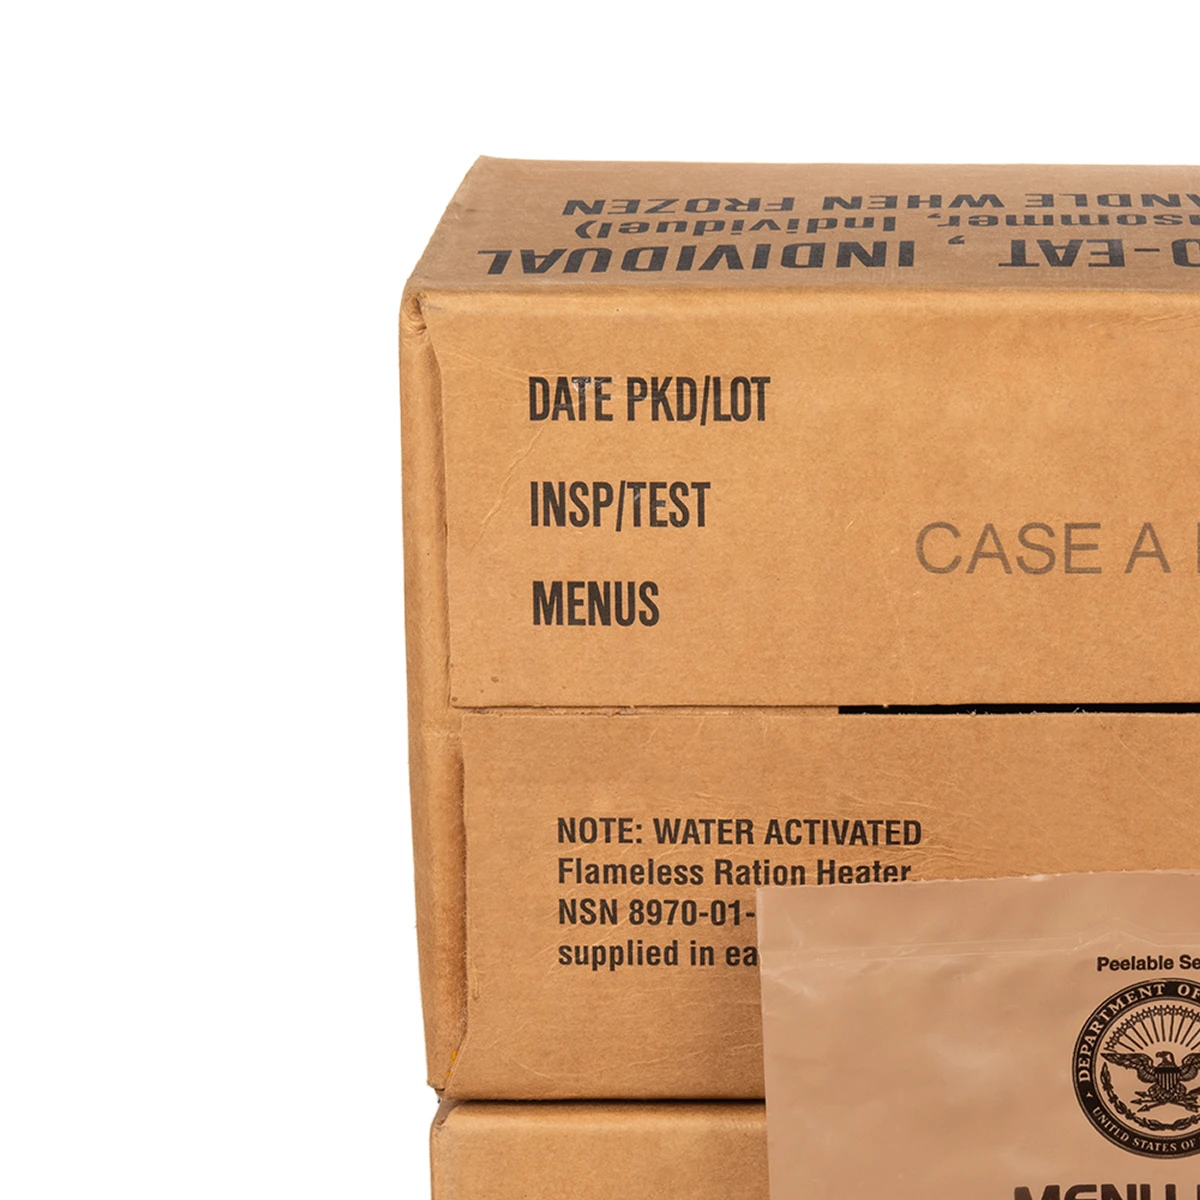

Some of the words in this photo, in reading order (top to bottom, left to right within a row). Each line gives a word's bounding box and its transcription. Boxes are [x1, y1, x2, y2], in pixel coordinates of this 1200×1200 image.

[561, 197, 796, 217] FROZEN
[822, 194, 1006, 211] WHEN
[575, 216, 897, 239] Individuel)
[477, 240, 916, 274] INDIVIDUAL
[528, 376, 613, 421] DATE
[626, 376, 771, 426] PKD/LOT
[530, 480, 711, 532] INSP/TEST
[914, 521, 1101, 576] CASE
[1124, 521, 1175, 575] A
[532, 580, 660, 627] MENUS
[557, 816, 643, 845] NOTE:
[653, 818, 755, 846] WATER
[764, 818, 922, 846] ACTIVATED
[558, 857, 703, 886] Flameless
[714, 858, 807, 887] Ration
[816, 859, 912, 885] Heater
[558, 898, 618, 926] NSN
[558, 939, 679, 972] supplied
[689, 940, 715, 967] in
[1096, 955, 1175, 972] Peelable
[1078, 982, 1167, 1083] DEPARTMENT
[1091, 1105, 1130, 1143] UNITED
[1131, 1136, 1178, 1153] STATES
[1180, 1137, 1197, 1152] OF
